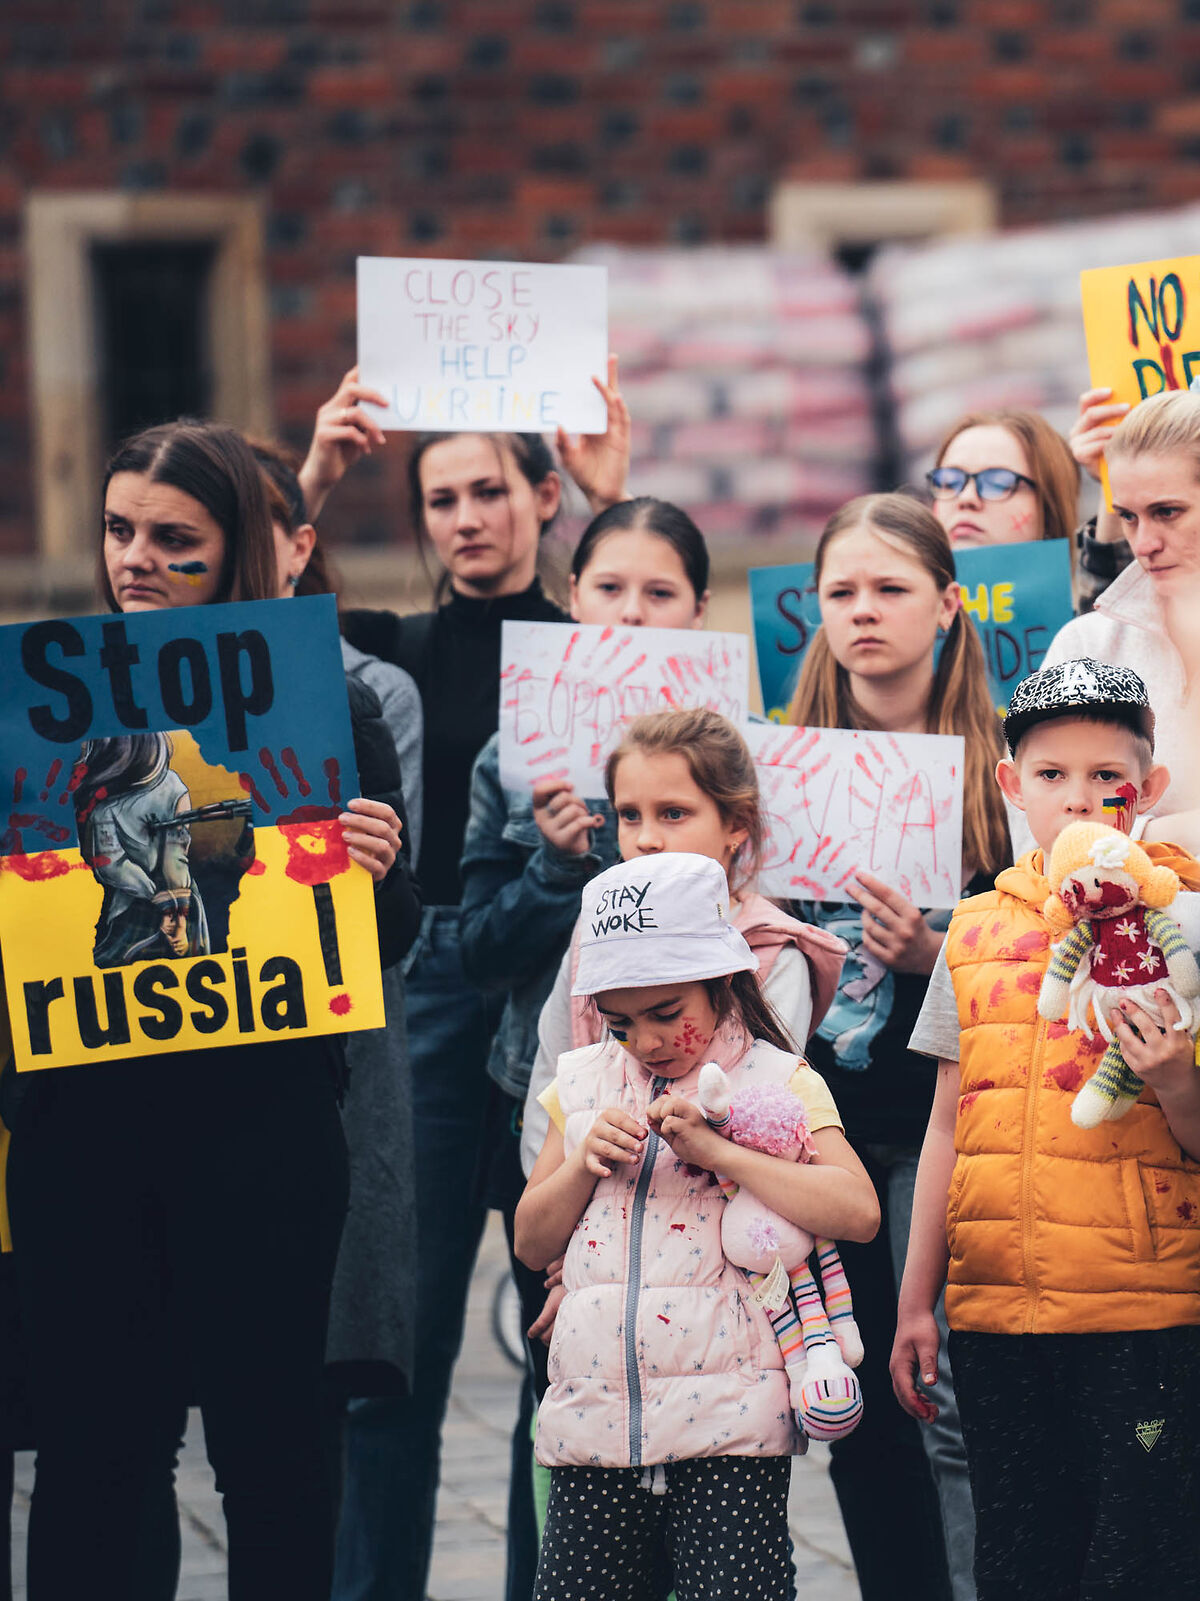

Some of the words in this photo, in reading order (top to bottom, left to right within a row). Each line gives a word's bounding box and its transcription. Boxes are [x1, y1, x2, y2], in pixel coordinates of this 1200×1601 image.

[404, 269, 534, 310] CLOSE
[414, 312, 470, 342] THE
[488, 311, 540, 343] SKY
[1125, 272, 1187, 350] NO
[440, 345, 528, 381] HELP
[959, 582, 1014, 623] HE
[20, 620, 275, 752] Stop
[596, 881, 652, 916] STAY
[591, 907, 659, 938] WOKE
